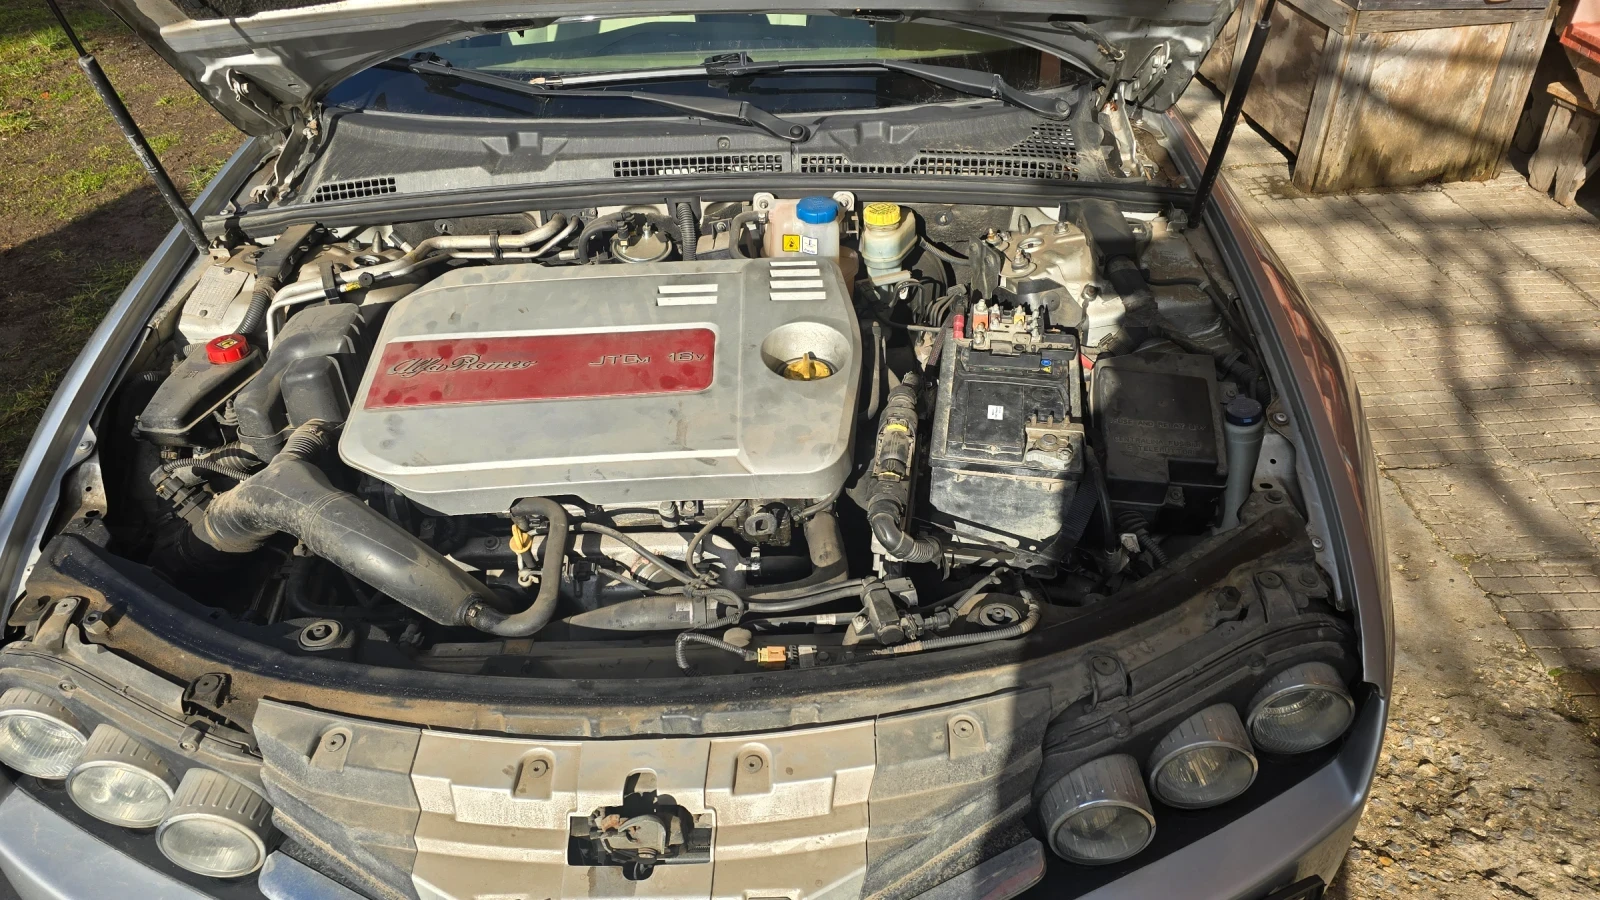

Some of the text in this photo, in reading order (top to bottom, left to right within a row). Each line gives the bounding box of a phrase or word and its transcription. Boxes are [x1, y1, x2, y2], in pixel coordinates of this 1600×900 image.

[387, 353, 537, 379] Alfa Romeo
[1137, 419, 1155, 428] AND
[1157, 421, 1186, 430] RELAY
[1112, 435, 1164, 446] CENTRALINA
